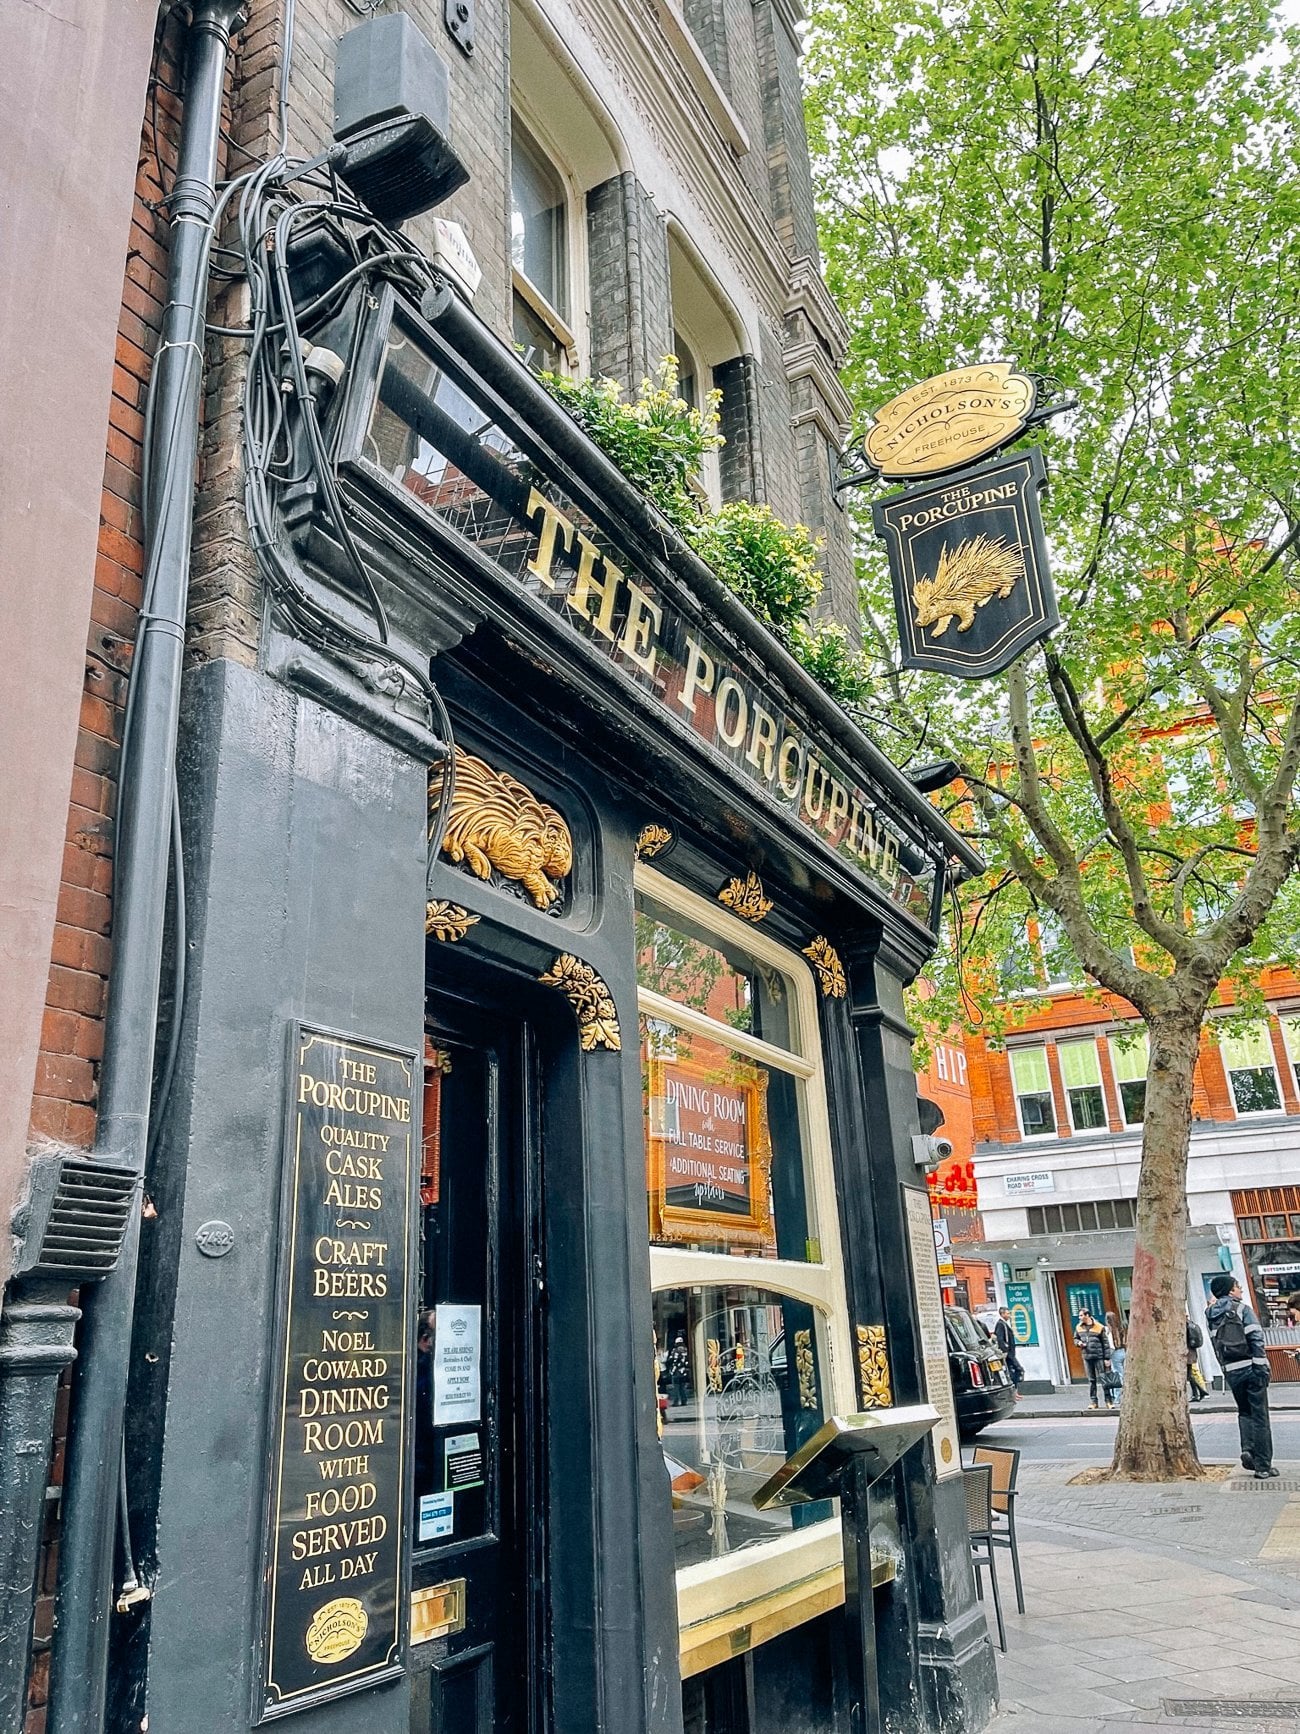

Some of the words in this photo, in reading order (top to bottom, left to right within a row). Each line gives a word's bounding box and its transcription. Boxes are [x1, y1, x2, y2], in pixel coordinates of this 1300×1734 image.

[912, 386, 937, 402] EST.
[943, 376, 972, 388] 1873
[886, 398, 1011, 450] NICHOLSON'S
[915, 425, 986, 454] FREEHOUSE
[900, 481, 1018, 532] PORCUPINE
[941, 487, 970, 503] THE
[526, 486, 662, 676] THE
[677, 636, 901, 887] PORCUPINE
[339, 1058, 377, 1084] THE
[935, 1045, 968, 1086] HIP
[298, 1074, 411, 1123] PORCUPINE
[666, 1079, 710, 1115] DINING
[713, 1093, 746, 1125] ROOM
[320, 1125, 391, 1152] QUALITY
[668, 1128, 687, 1147] FULL
[688, 1132, 712, 1152] TABLE
[714, 1138, 745, 1159] SERVICE
[326, 1150, 384, 1180] CASK
[671, 1158, 717, 1180] ADDITIONAL
[718, 1167, 746, 1185] SEATING
[1006, 1175, 1030, 1183] CHARING
[323, 1179, 382, 1210] ALES
[315, 1236, 388, 1267] CRAFT
[313, 1268, 387, 1298] BEERS
[321, 1330, 375, 1353] NOEL
[303, 1358, 388, 1382] COWARD
[299, 1385, 389, 1418] DINING
[304, 1418, 384, 1454] ROOM
[319, 1455, 370, 1480] WITH
[305, 1482, 377, 1520] FOOD
[291, 1515, 388, 1561] SERVED
[299, 1563, 335, 1591] ALL
[340, 1552, 379, 1581] DAY
